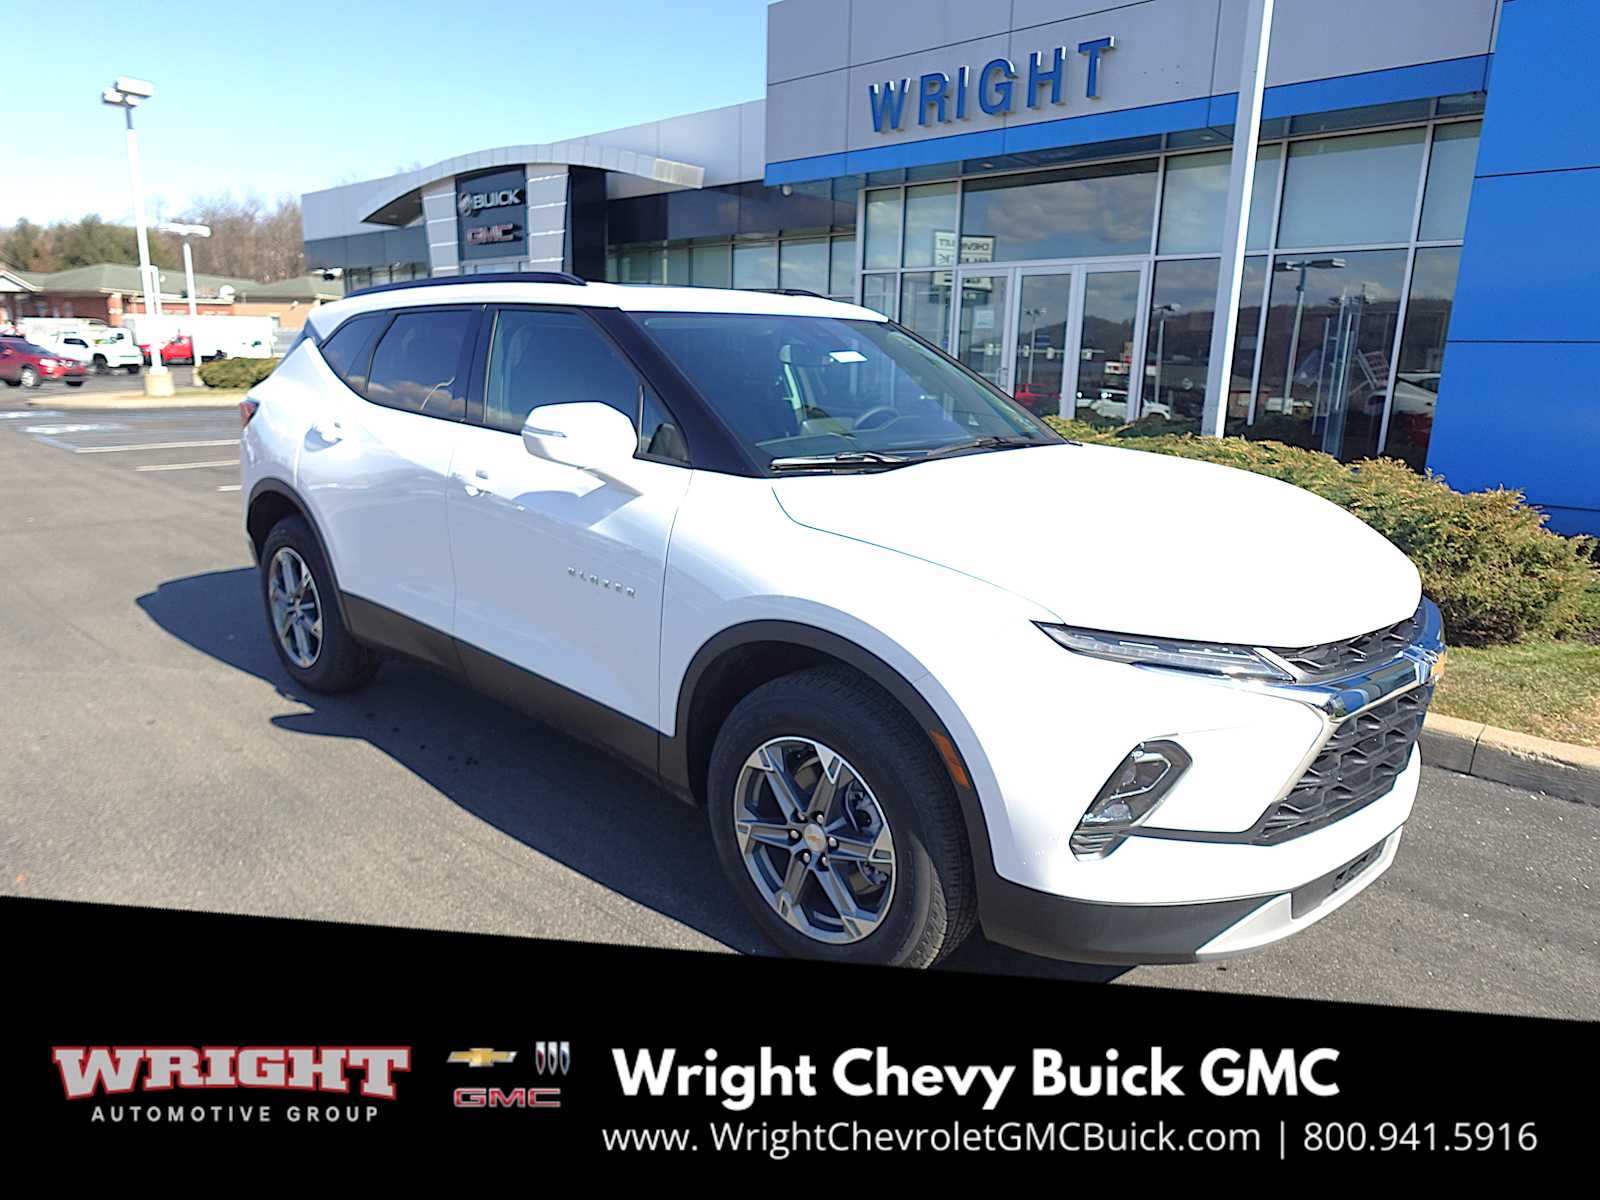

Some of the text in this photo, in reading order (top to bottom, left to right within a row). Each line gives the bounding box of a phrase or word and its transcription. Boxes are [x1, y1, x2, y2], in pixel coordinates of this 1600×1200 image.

[868, 35, 1115, 132] WRIGHT
[472, 188, 521, 210] BUICK
[465, 223, 514, 245] GMC
